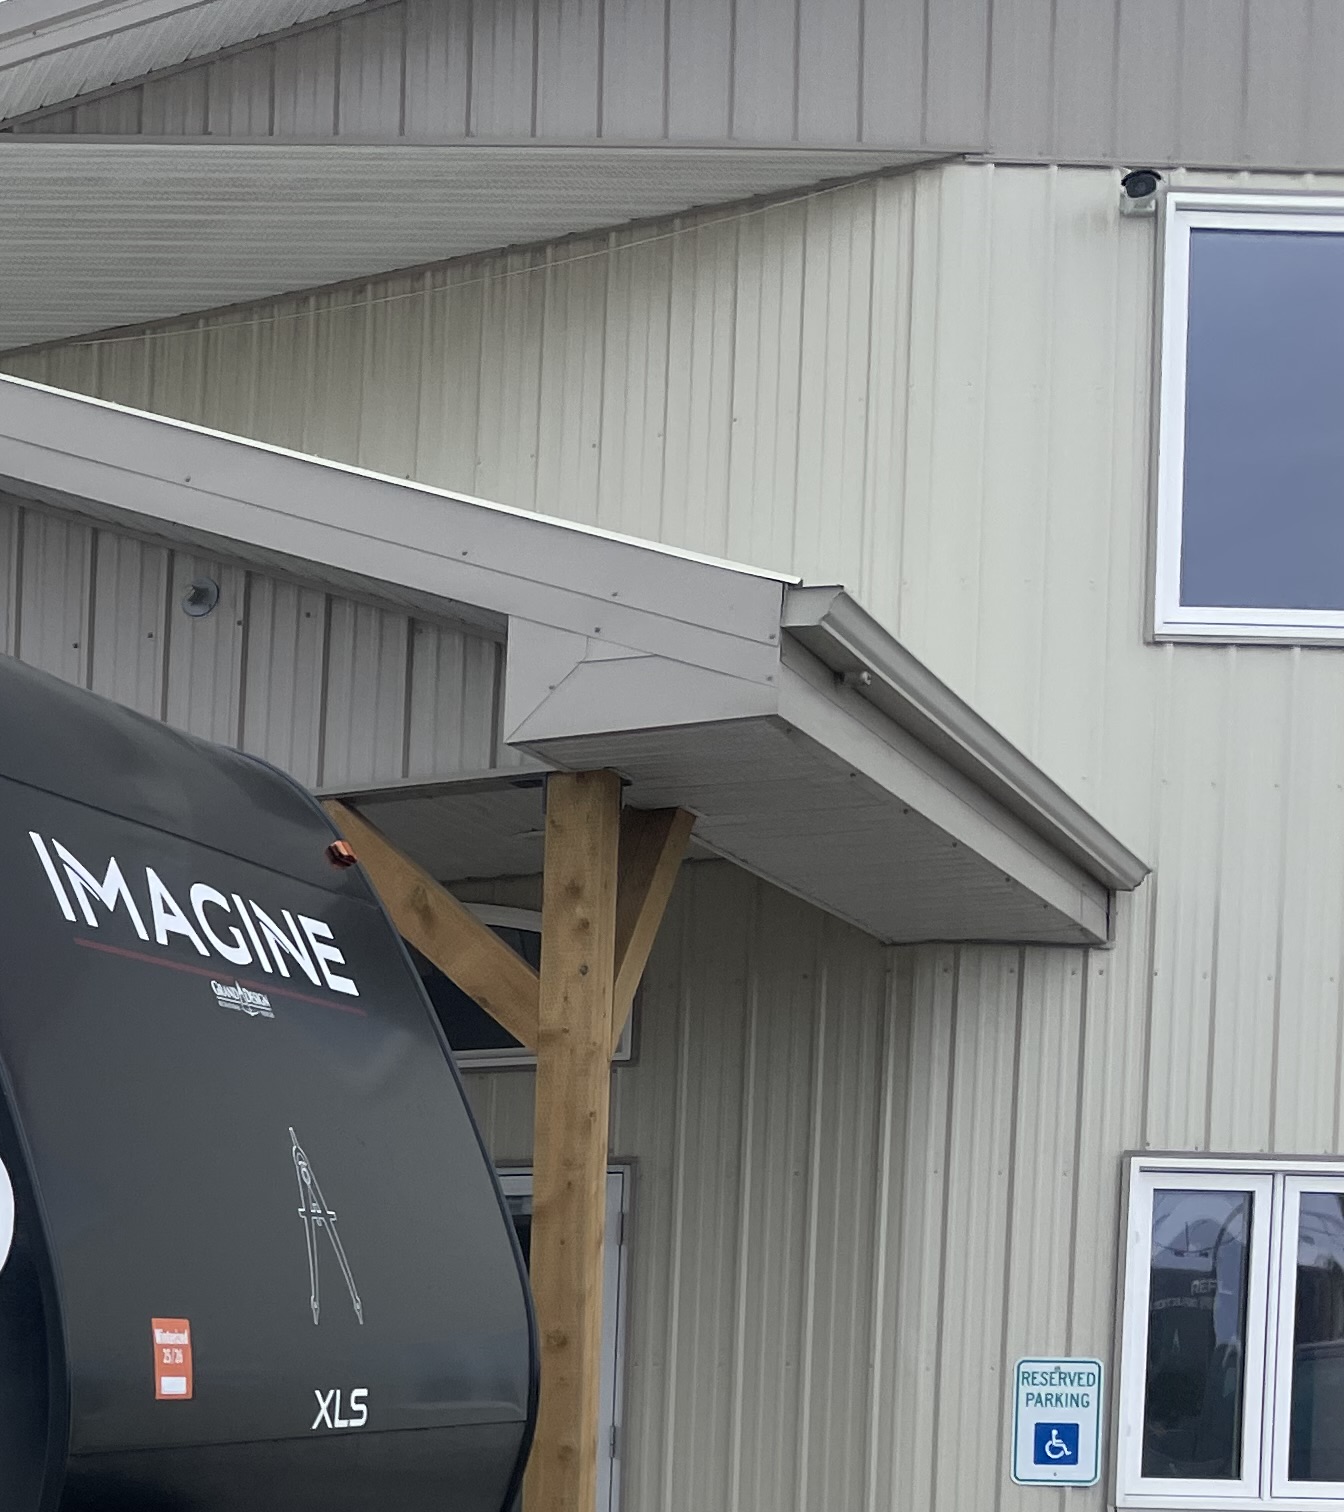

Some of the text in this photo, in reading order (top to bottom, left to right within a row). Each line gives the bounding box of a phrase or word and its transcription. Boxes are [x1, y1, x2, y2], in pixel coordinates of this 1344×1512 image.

[28, 830, 360, 996] IMAGINE
[1021, 1371, 1096, 1387] RESERVED
[311, 1388, 369, 1430] XLS
[1025, 1392, 1090, 1408] PARKING
